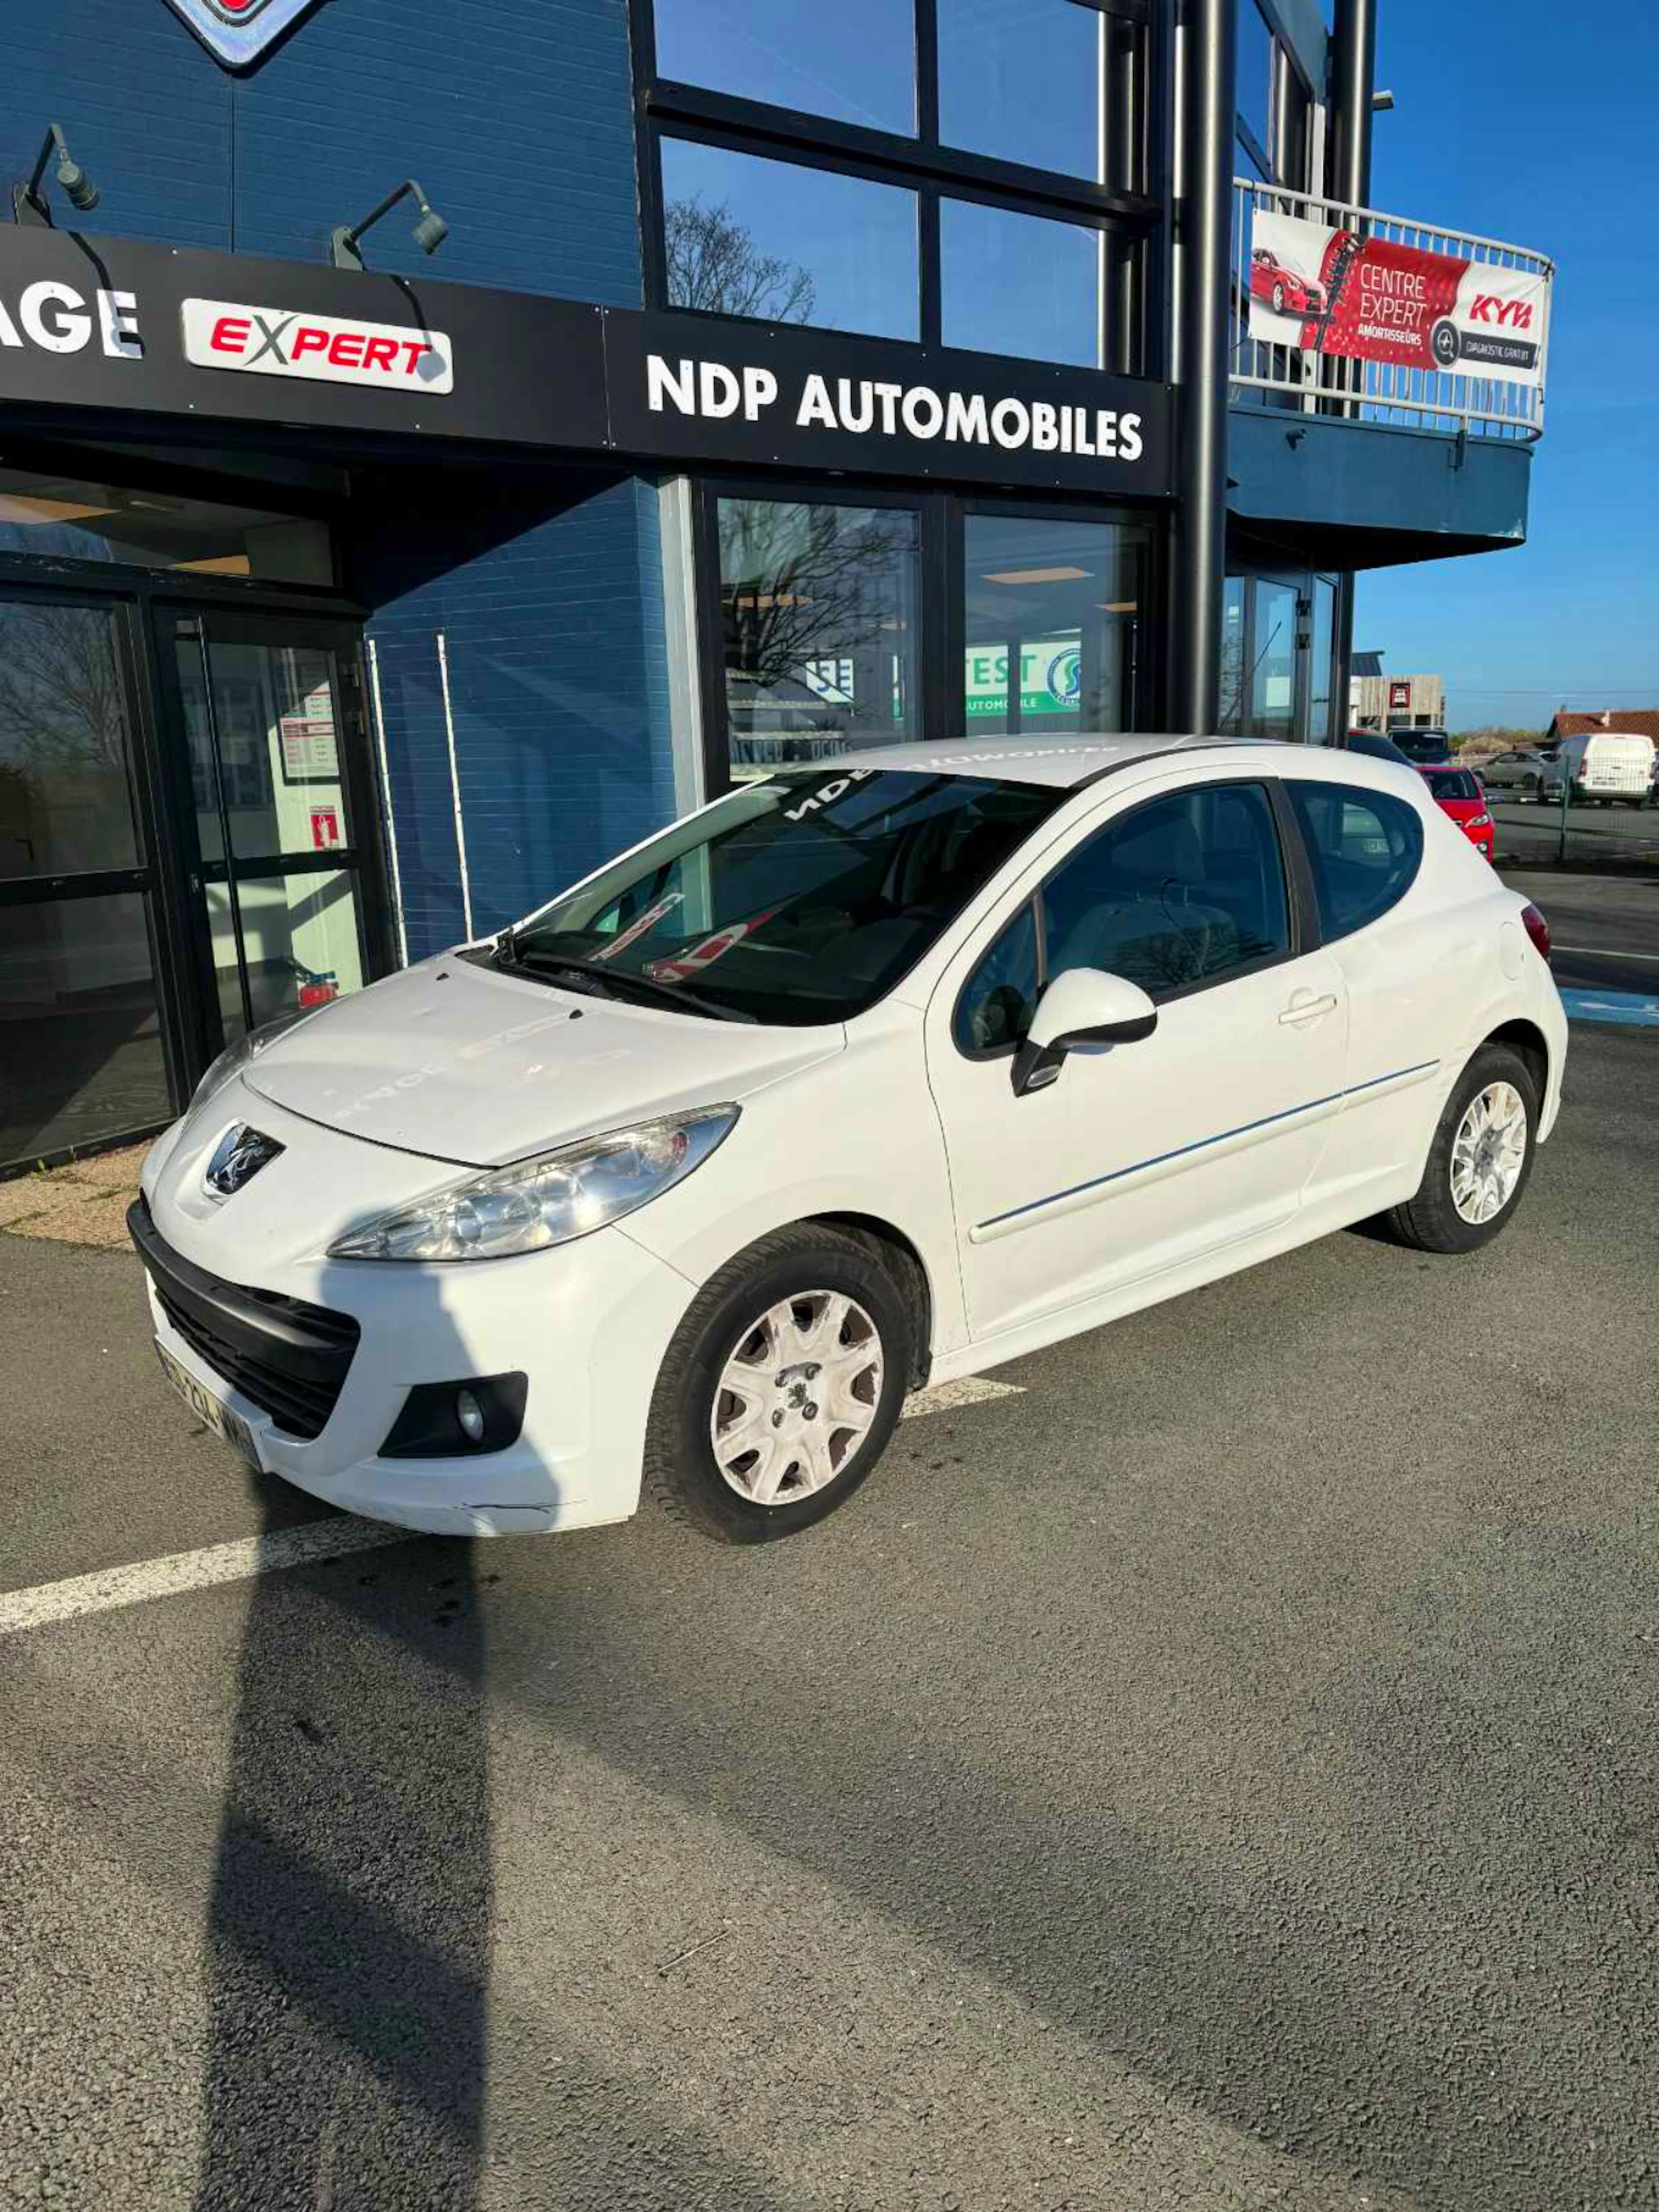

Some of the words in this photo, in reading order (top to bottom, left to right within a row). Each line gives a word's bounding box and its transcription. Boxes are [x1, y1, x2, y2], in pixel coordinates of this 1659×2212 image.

[1361, 264, 1426, 299] CENTRE
[1360, 292, 1427, 327] EXPERT
[1469, 294, 1532, 328] KYB
[1357, 323, 1422, 345] AMORTISSEURS
[647, 354, 778, 421] NDP
[796, 374, 1143, 461] AUTOMOBILES
[966, 655, 1037, 685] EST
